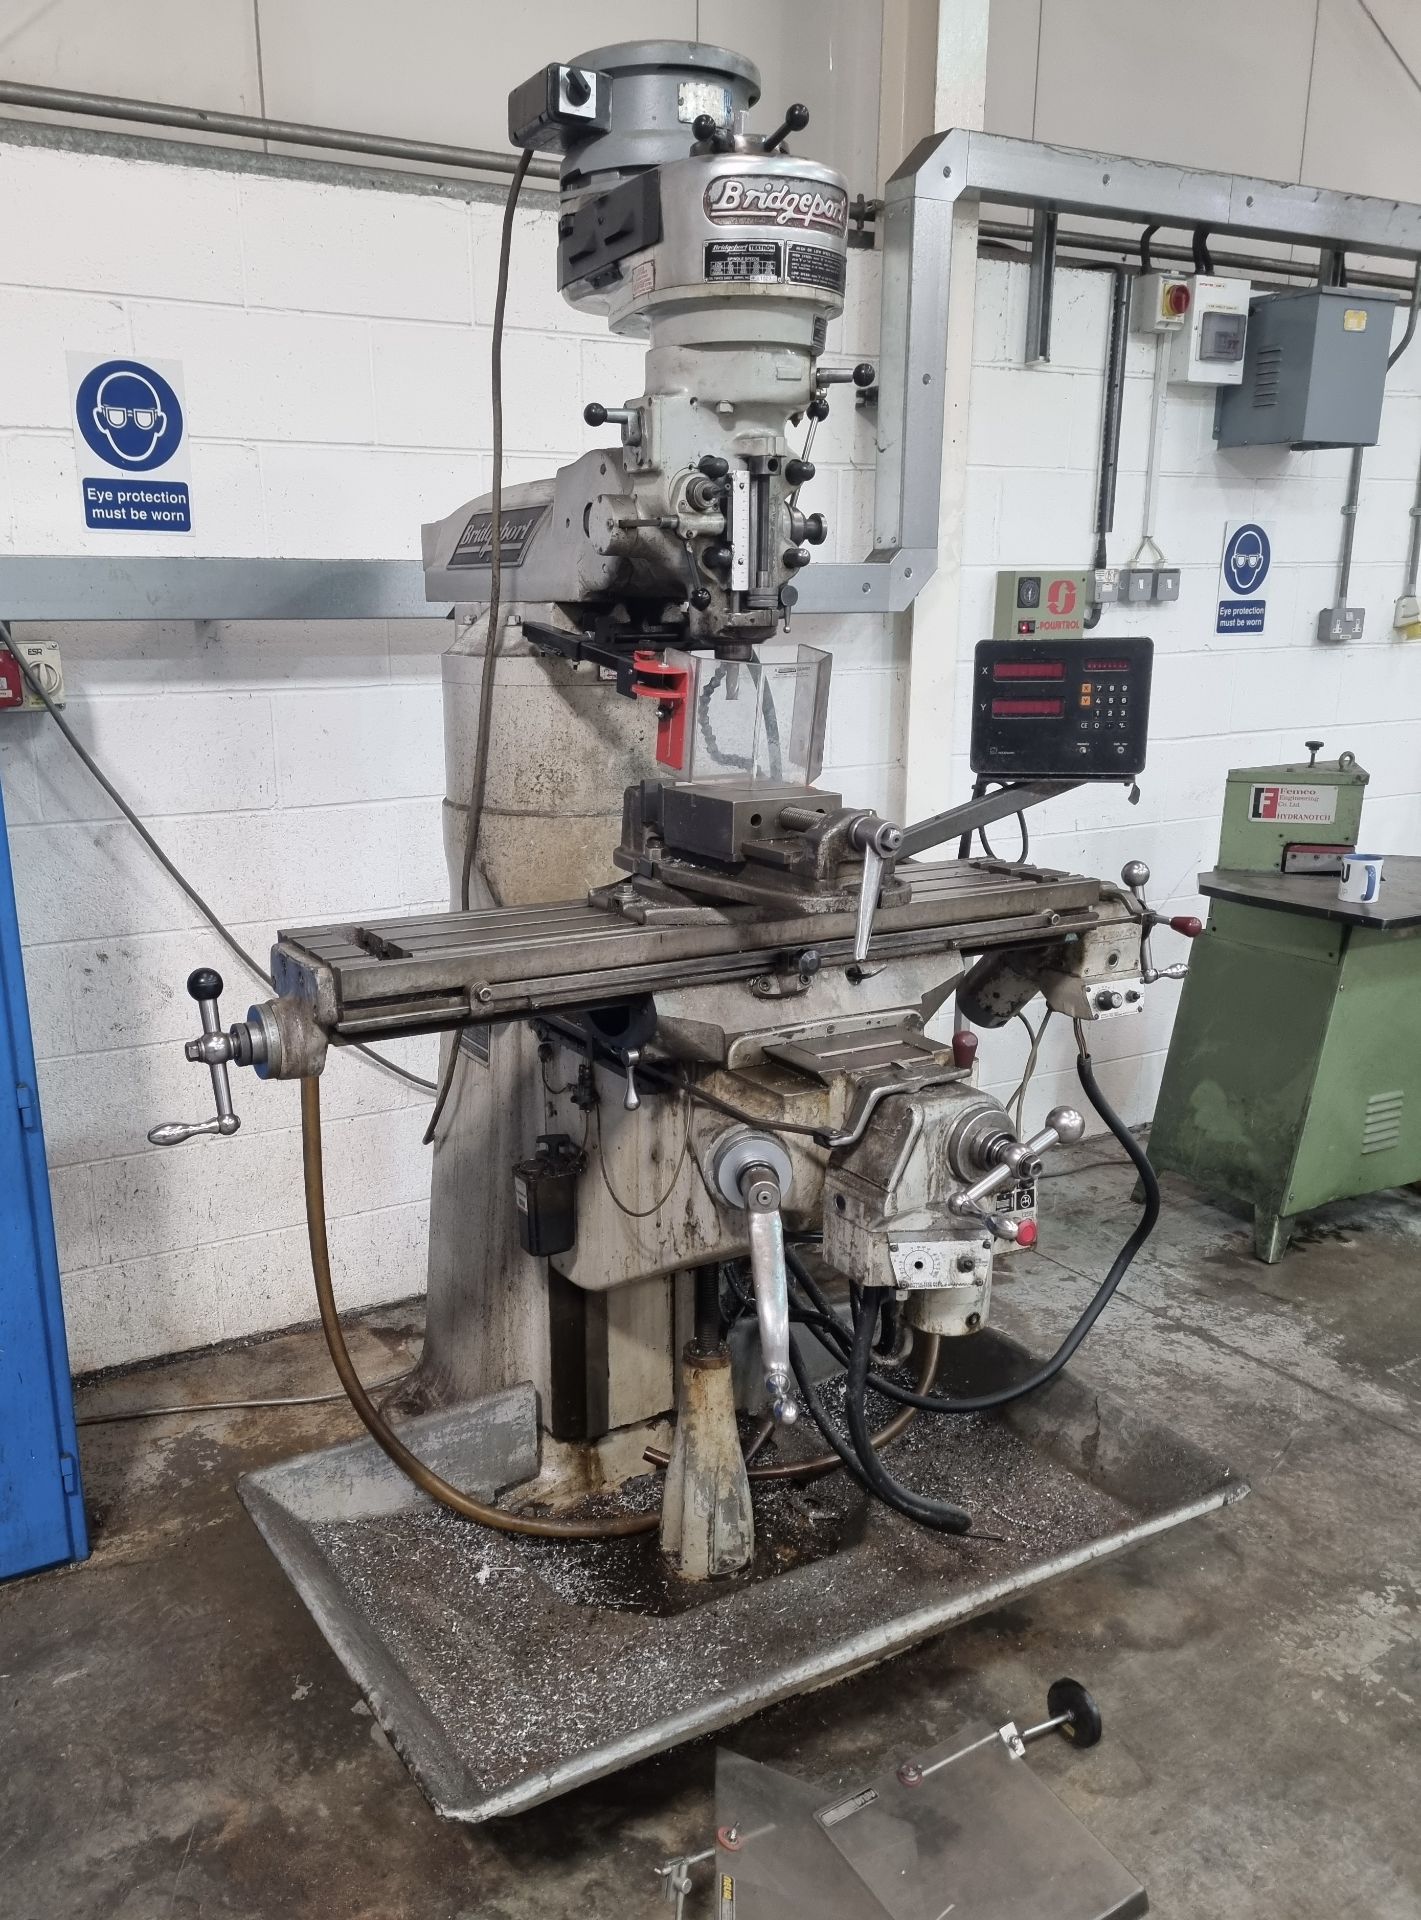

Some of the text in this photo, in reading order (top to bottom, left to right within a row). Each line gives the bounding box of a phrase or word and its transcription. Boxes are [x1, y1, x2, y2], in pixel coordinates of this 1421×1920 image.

[711, 181, 846, 227] Bridgeport
[750, 244, 776, 252] TEXTRON
[87, 487, 187, 504] Eye protection
[92, 507, 185, 521] must be worn
[459, 518, 537, 559] Bridgport
[1219, 606, 1265, 618] Eye protection
[1219, 618, 1236, 627] must
[1236, 618, 1245, 626] be
[27, 648, 43, 656] ESR
[981, 666, 989, 675] X
[980, 703, 988, 711] Y
[1277, 812, 1331, 821] HYDRANOTCH
